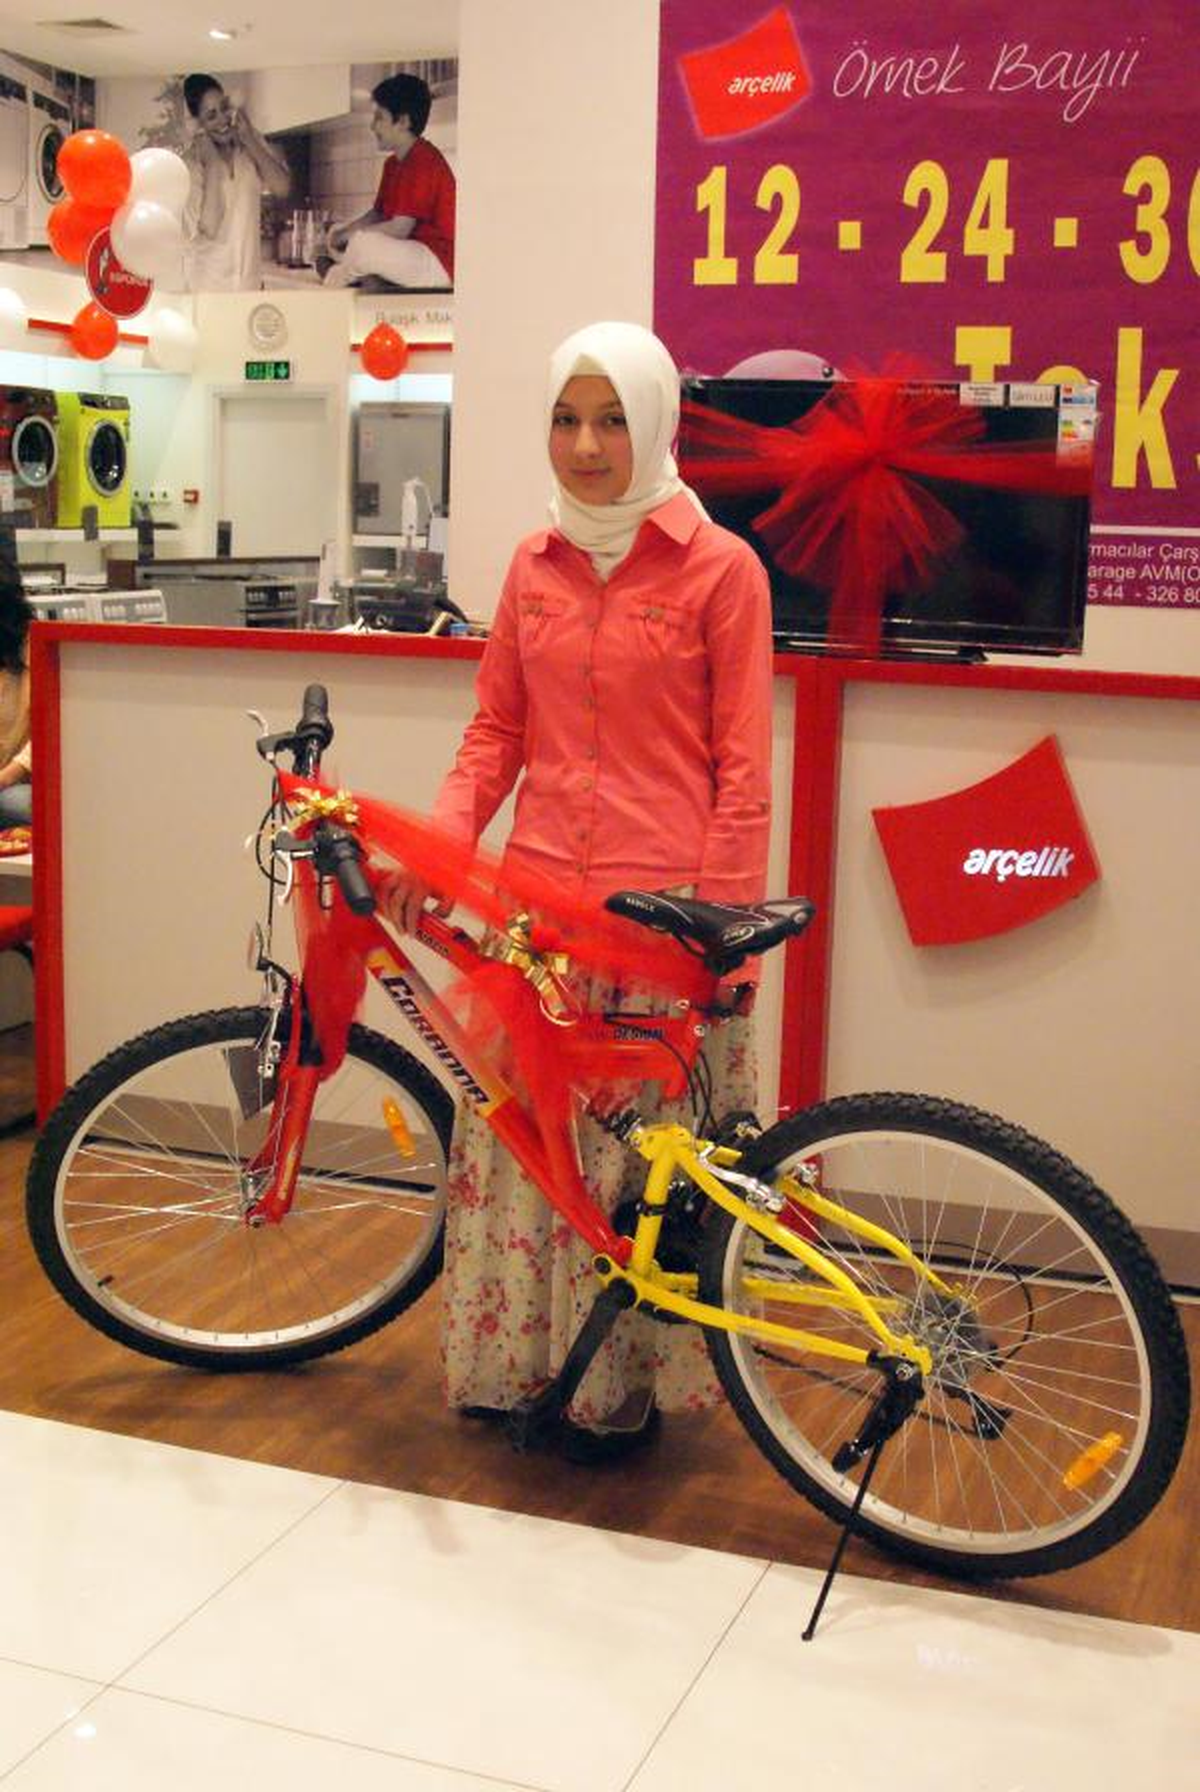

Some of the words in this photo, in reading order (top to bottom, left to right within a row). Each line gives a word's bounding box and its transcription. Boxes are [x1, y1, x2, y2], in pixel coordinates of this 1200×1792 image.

[727, 71, 797, 97] arçelik
[832, 39, 964, 98] Örnek
[987, 35, 1146, 123] Bayii
[693, 163, 801, 285] 12
[899, 157, 1015, 283] 24
[1118, 154, 1200, 285] 3
[954, 325, 1200, 489] Tk
[1102, 584, 1124, 600] 44
[1146, 585, 1179, 603] 326
[962, 845, 1076, 883] arçelik
